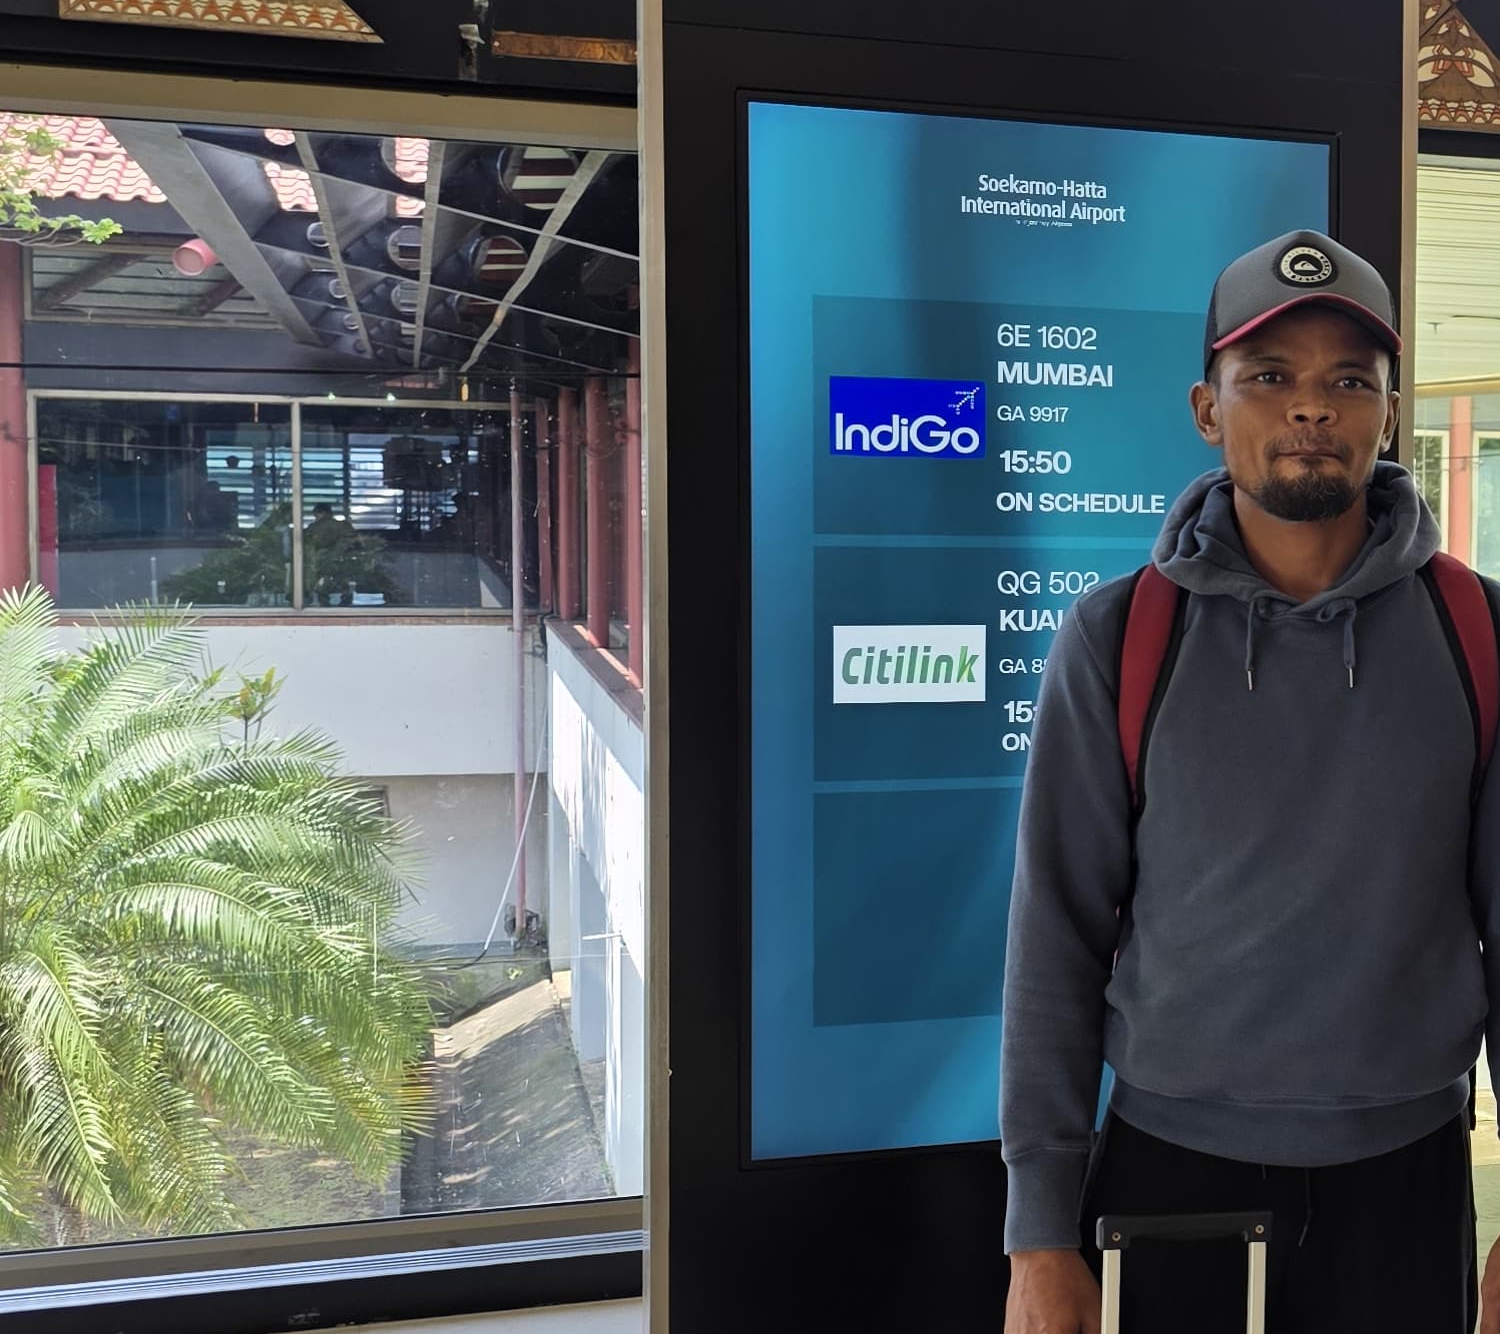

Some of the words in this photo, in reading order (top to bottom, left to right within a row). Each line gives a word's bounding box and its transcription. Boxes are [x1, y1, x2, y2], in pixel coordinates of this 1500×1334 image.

[978, 173, 1107, 199] Soekarno-Hatta
[961, 195, 1066, 219] International
[1070, 201, 1126, 225] Airport
[997, 323, 1031, 348] 6E
[1037, 325, 1097, 350] 1602
[997, 360, 1113, 388] MUMBAI
[996, 405, 1026, 422] GA
[1029, 406, 1069, 423] 9917
[835, 412, 980, 454] IndiGo
[1000, 450, 1072, 474] 15:50
[996, 492, 1033, 513] ON
[1038, 493, 1166, 514] SCHEDULE
[997, 570, 1041, 596] QG
[1048, 571, 1100, 595] 502
[841, 645, 980, 685] Citilink
[998, 658, 1028, 674] GA
[1002, 733, 1032, 752] ON
